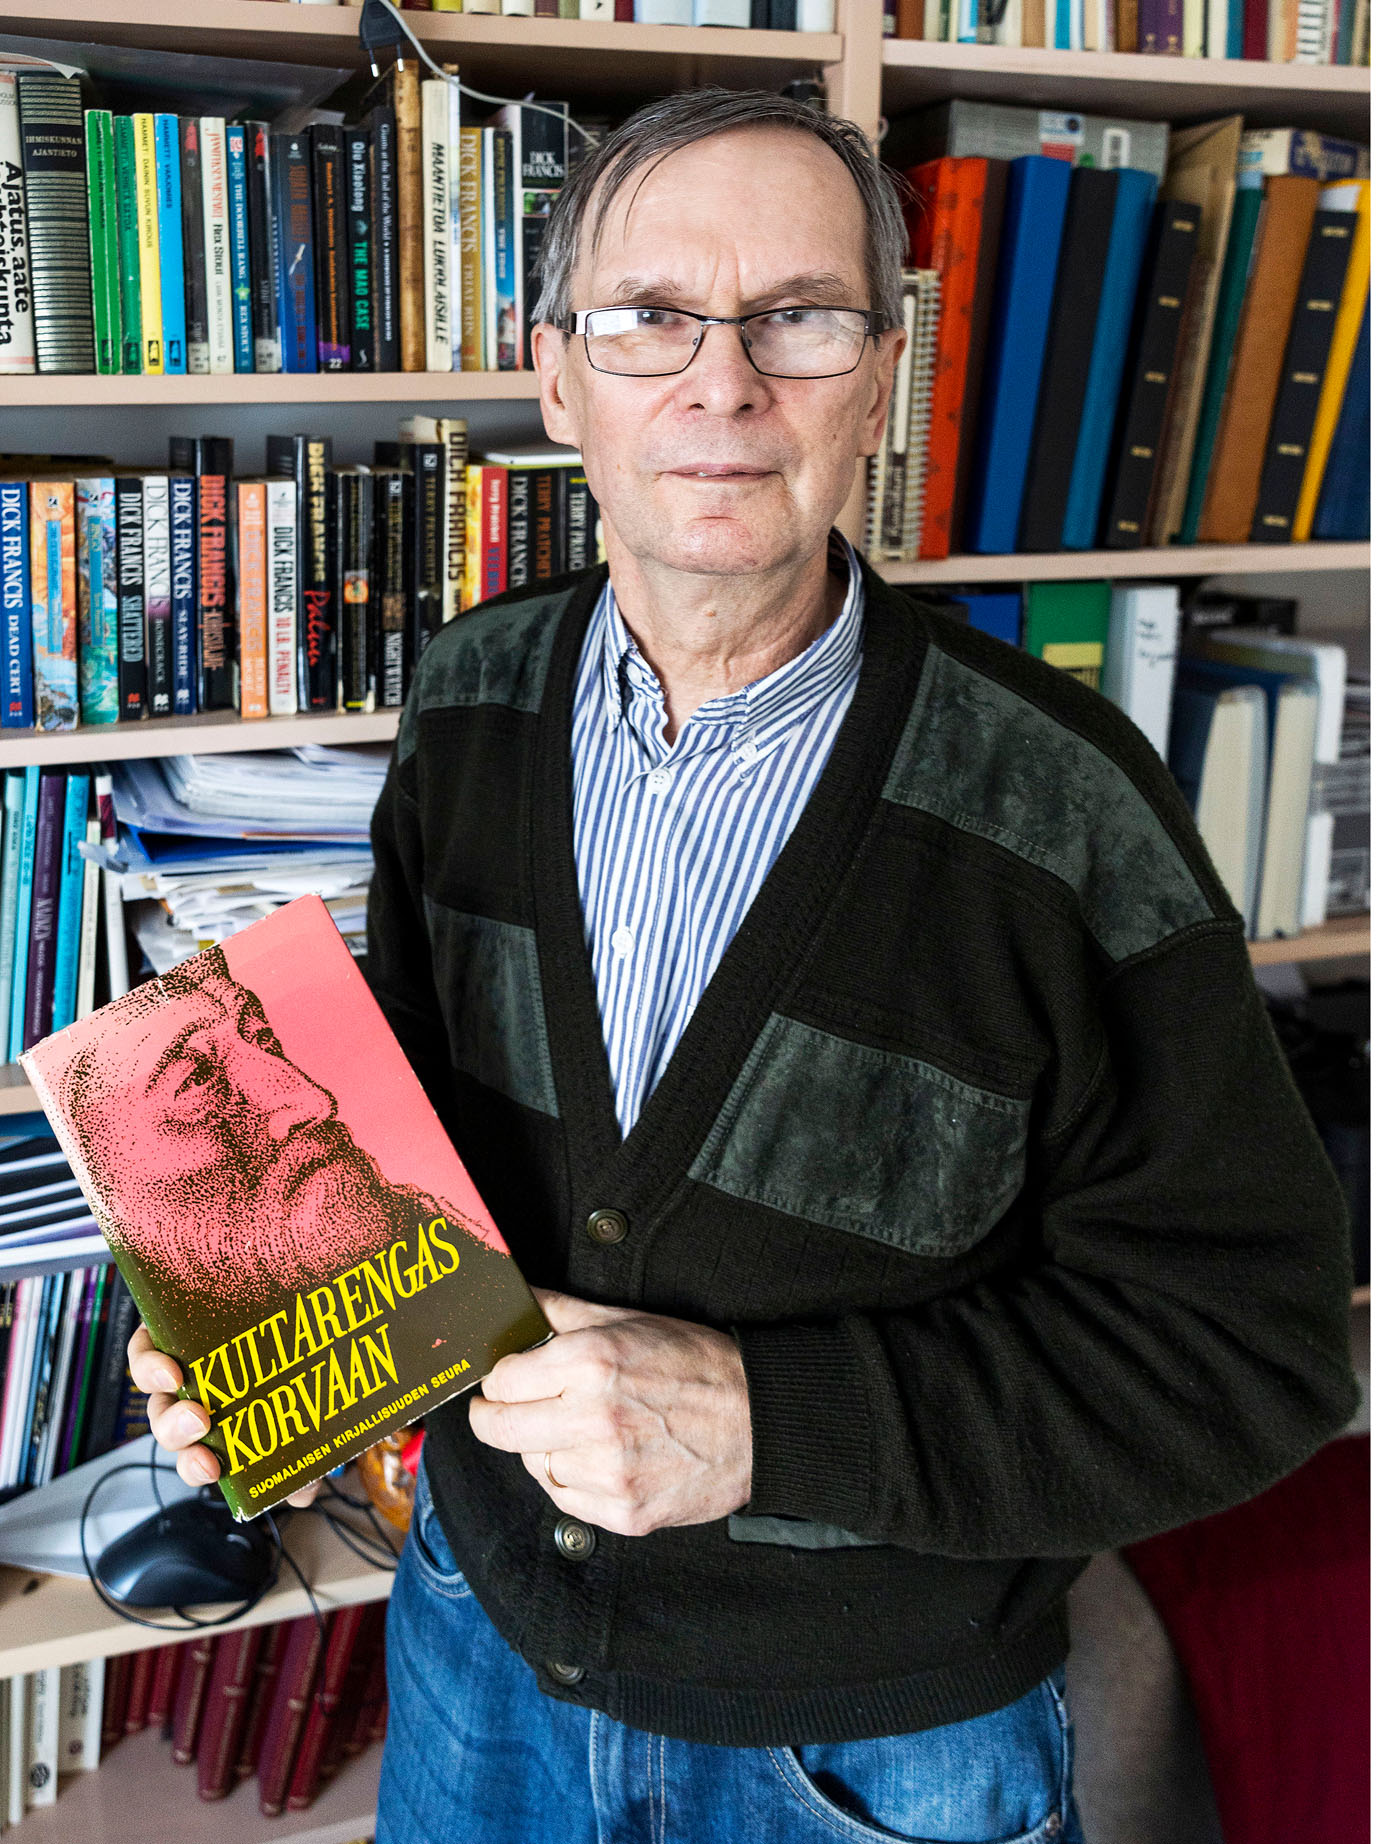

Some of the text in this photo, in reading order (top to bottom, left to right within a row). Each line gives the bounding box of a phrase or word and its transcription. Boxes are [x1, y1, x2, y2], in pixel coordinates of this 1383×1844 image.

[142, 159, 151, 186] DAININ
[234, 183, 243, 202] THE
[350, 162, 368, 212] Xiaolong
[382, 174, 392, 191] End
[431, 142, 446, 234] MAANTIETOA
[460, 133, 479, 254] DICK FRANCIS
[528, 151, 556, 165] DICK
[3, 161, 31, 314] Ajatus, aate
[213, 223, 225, 275] Rex Stout
[383, 215, 393, 241] World
[0, 204, 13, 345] hteiskunta
[354, 241, 370, 331] THE MAO CASE
[328, 357, 343, 370] 22
[146, 485, 168, 532] DICK
[308, 442, 326, 583] DICK FRANCIS
[448, 491, 467, 582] FRANCIS
[510, 475, 528, 518] DICK
[536, 475, 552, 513] TERRY
[568, 492, 586, 571] TERRY PRATC
[1, 488, 24, 609] DICK FRANCIS
[119, 492, 143, 586] DICK FRANCIS
[173, 482, 193, 600] DICK FRANCIS
[200, 474, 226, 608] DICK FRANCIS
[273, 525, 294, 613] DICK FRANCIS
[8, 614, 22, 697] DEAD CERT
[122, 595, 144, 662] SHATTERED
[188, 1216, 461, 1416] KULTARENGAS
[216, 1323, 399, 1476] KORVAAN
[248, 1359, 472, 1499] SUOMALAISEN KIRJALLISUUDEN SEURA
